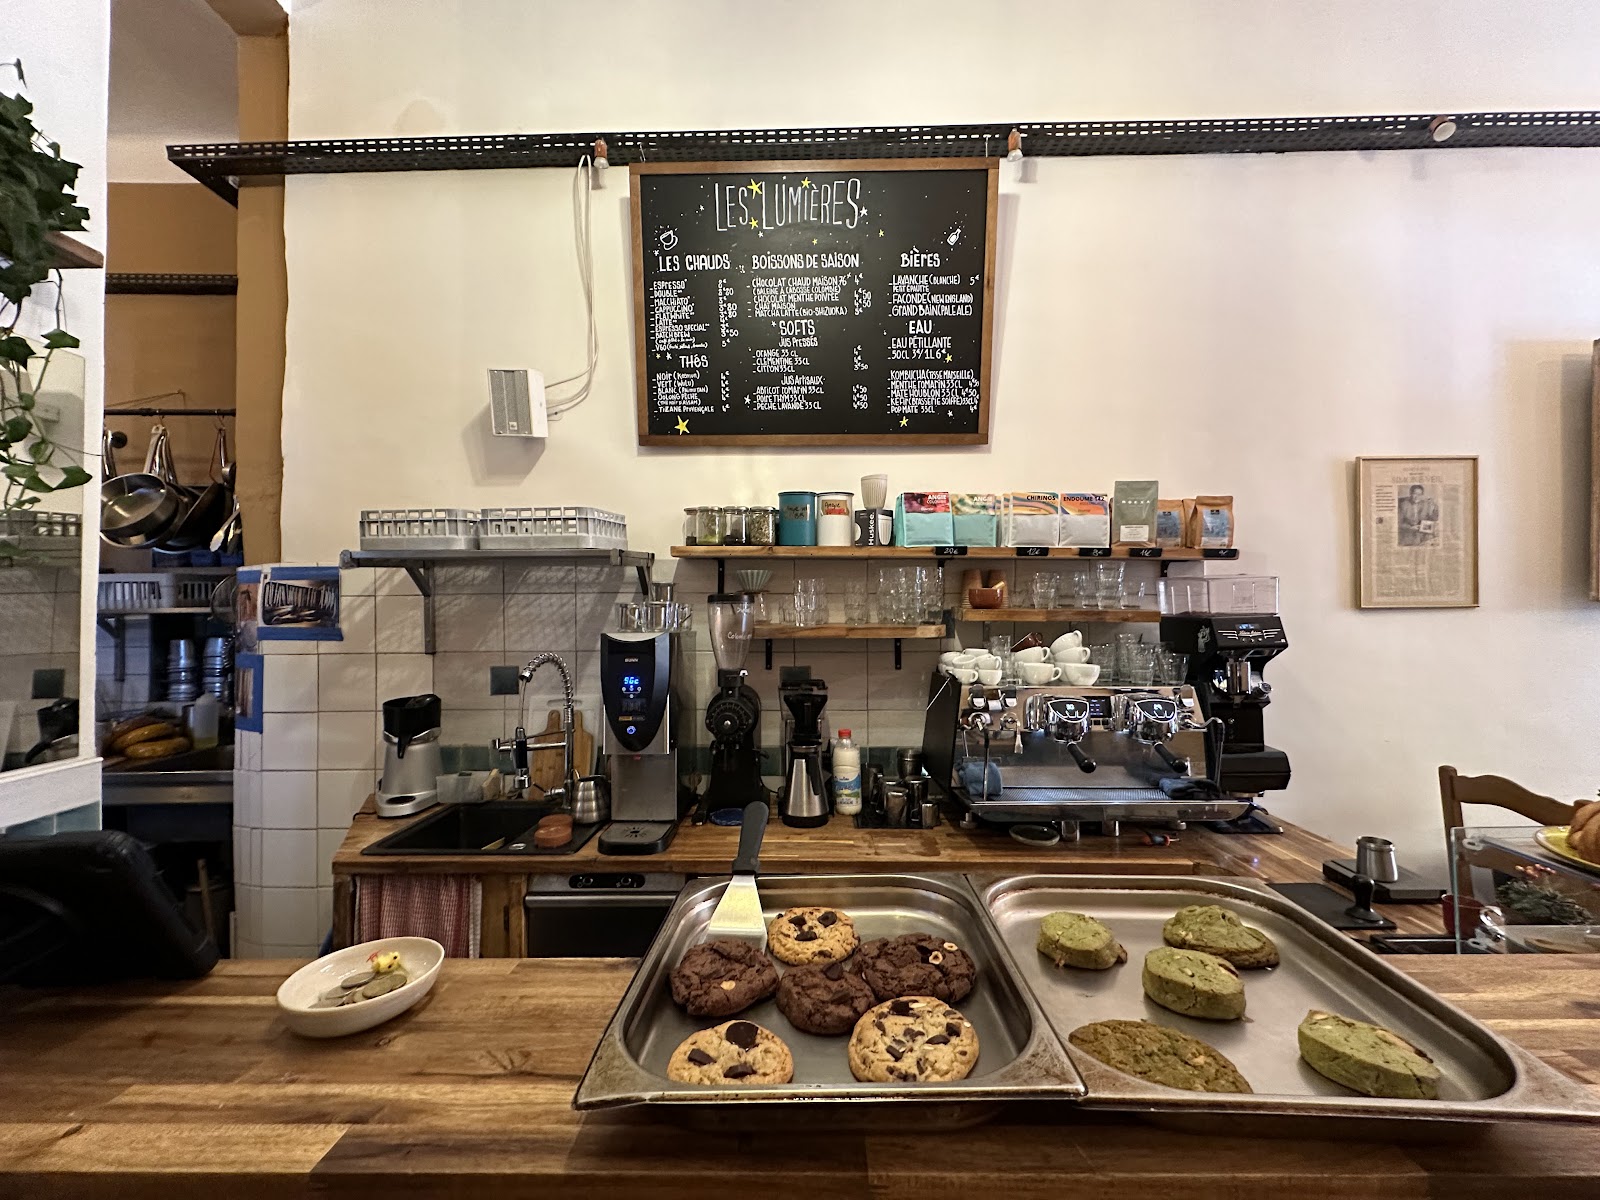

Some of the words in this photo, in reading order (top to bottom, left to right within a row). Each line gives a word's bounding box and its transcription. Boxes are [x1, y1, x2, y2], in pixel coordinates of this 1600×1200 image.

[715, 183, 749, 231] LES
[762, 178, 861, 230] LUMIÈRES
[659, 255, 680, 272] LES
[685, 254, 731, 271] CHAUDS
[752, 251, 804, 269] BOISSONS
[806, 254, 818, 268] DE
[821, 252, 859, 268] SAISON
[752, 276, 786, 288] CHOCOLAT
[788, 277, 811, 287] CHAUD
[654, 290, 678, 298] DOUBLE
[754, 294, 787, 303] CHOCOLAT
[788, 293, 814, 302] MENTHE
[654, 298, 689, 307] MACCHIATO
[779, 319, 815, 336] SOFTS
[908, 320, 932, 334] EAU
[891, 337, 907, 349] EAU
